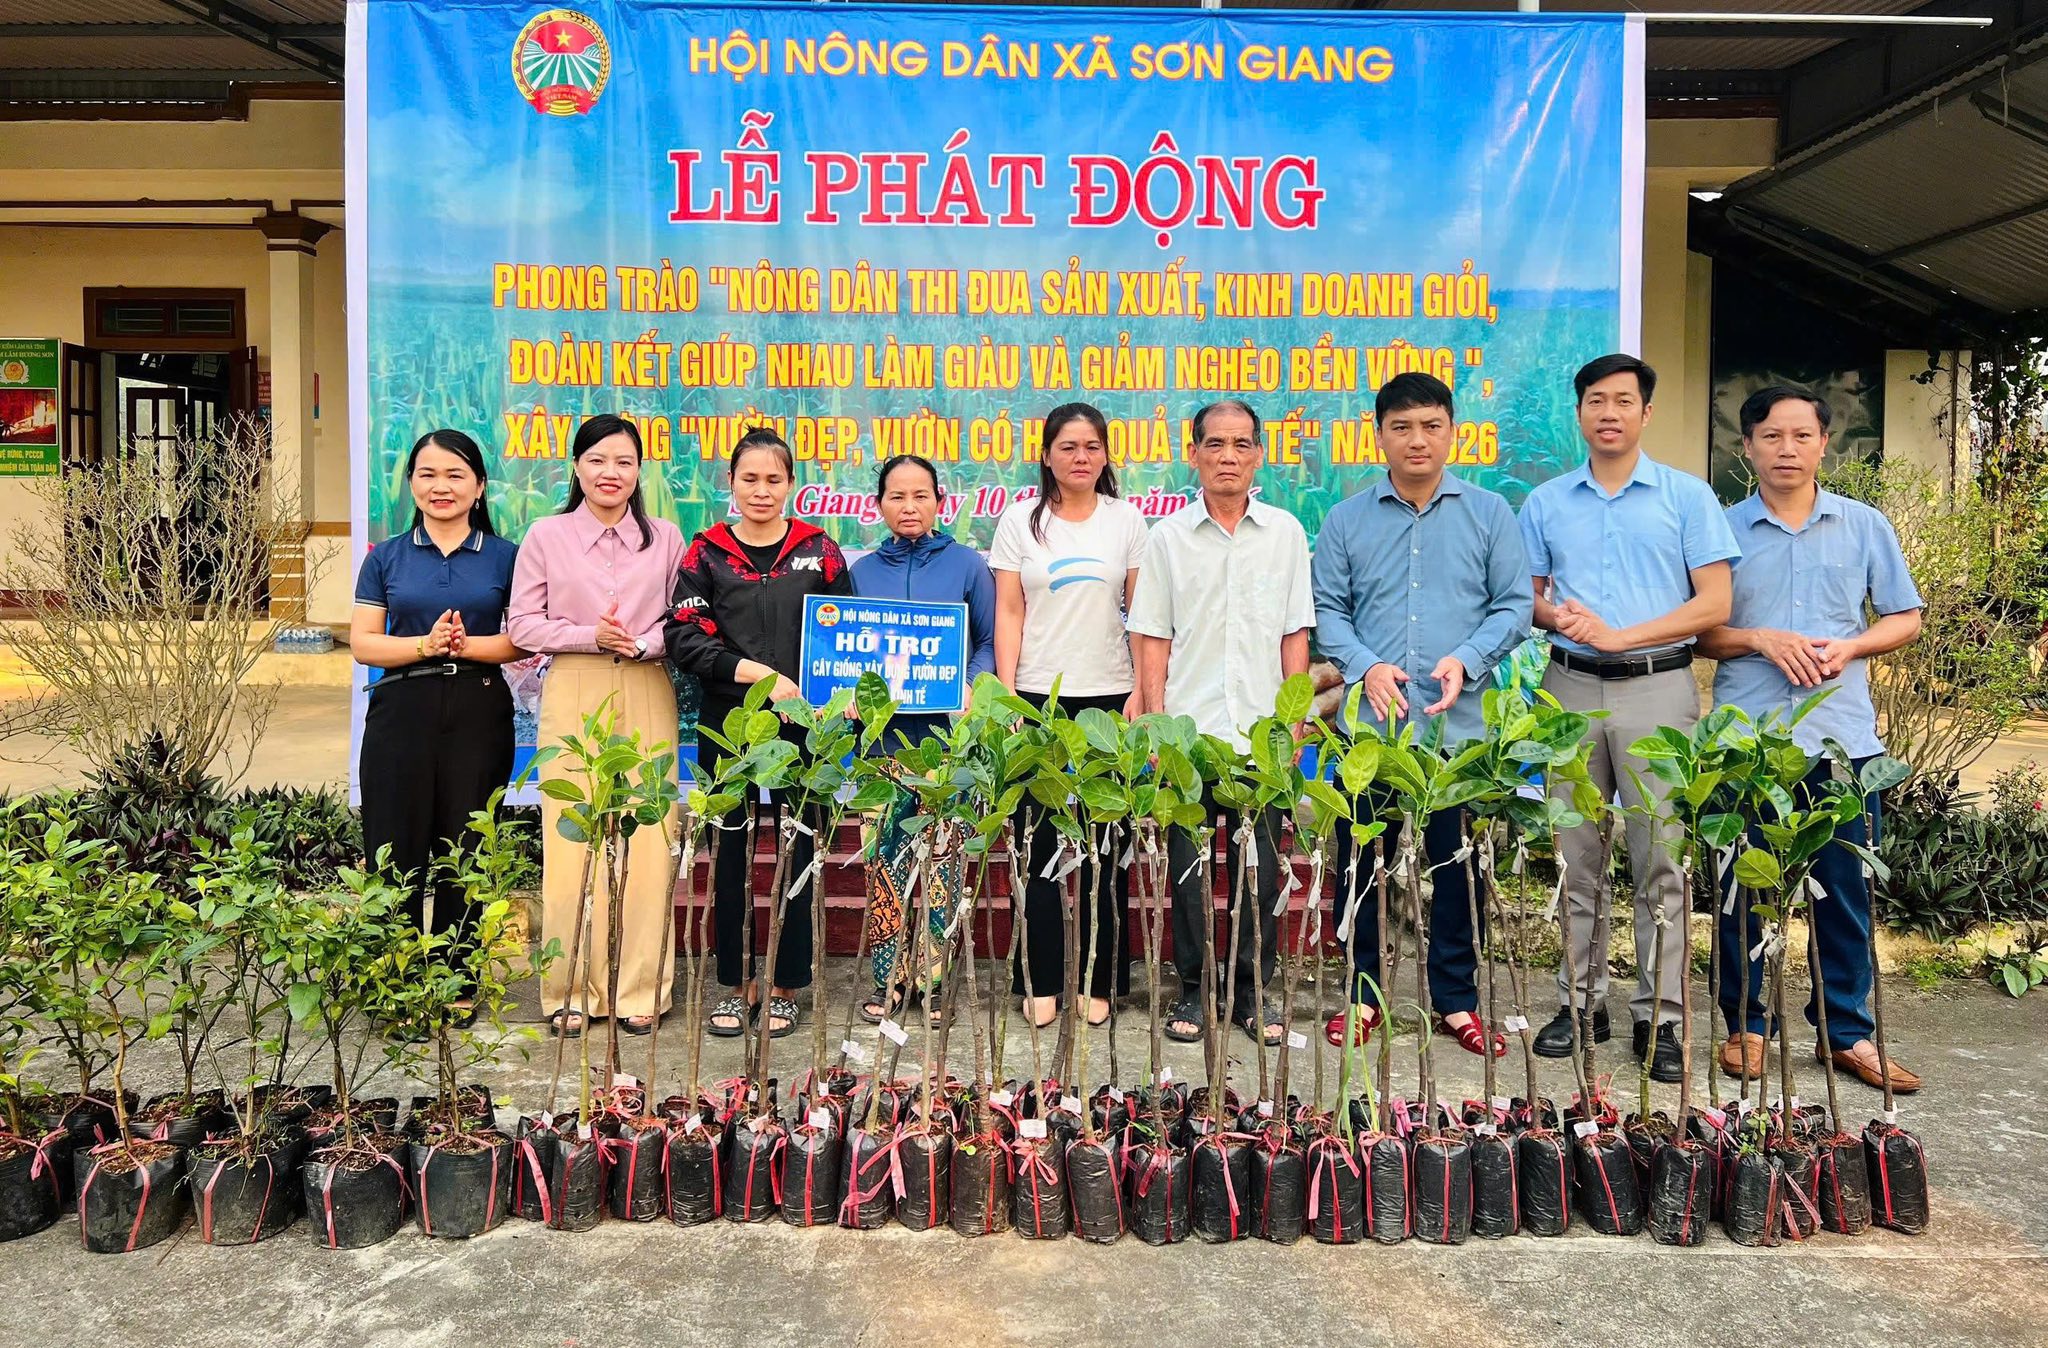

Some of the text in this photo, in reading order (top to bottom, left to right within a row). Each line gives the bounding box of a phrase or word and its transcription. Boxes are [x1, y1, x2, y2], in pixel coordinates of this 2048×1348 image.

[689, 29, 1394, 82] HỘI NÔNG DÂN XÃ SƠN GIANG
[667, 108, 1326, 250] LỄ PHÁT ĐỘNG
[493, 255, 1498, 324] PHONG TRÀO "NÔNG DÂN THI ĐUA SẢN XUẤT, KINH DOANH GIỎI,
[509, 332, 603, 386] ĐOÀN
[611, 328, 672, 387] KẾT
[679, 333, 757, 388] GIÚP
[766, 342, 855, 389] NHAU
[863, 334, 934, 389] LÀM
[943, 335, 1020, 390] GIÀU
[1029, 335, 1071, 390] VÀ
[1080, 331, 1165, 390] GIẢM
[1174, 337, 1281, 392] NGHÈO
[1290, 332, 1357, 391] BỀN
[1365, 338, 1455, 391] VỮNG
[503, 404, 573, 459] XÂY
[793, 416, 862, 471] ĐẸP,
[872, 407, 960, 461] VƯỜN
[969, 409, 1013, 463] CÓ
[1107, 404, 1172, 468] QUẢ
[1263, 405, 1321, 465] TẾ"
[1331, 410, 1388, 465] NĂ
[969, 485, 1008, 518] 10
[1126, 485, 1189, 519] năm
[842, 609, 956, 628] HỘI NÔNG DÂN XÃ SƠN GIANG
[835, 626, 942, 660] HỖ TRỢ
[812, 657, 831, 677] CÂY
[833, 656, 862, 678] GIỐNG
[912, 661, 937, 681] VƯỜN
[939, 665, 958, 684] ĐẸP
[915, 684, 927, 705] TẾ
